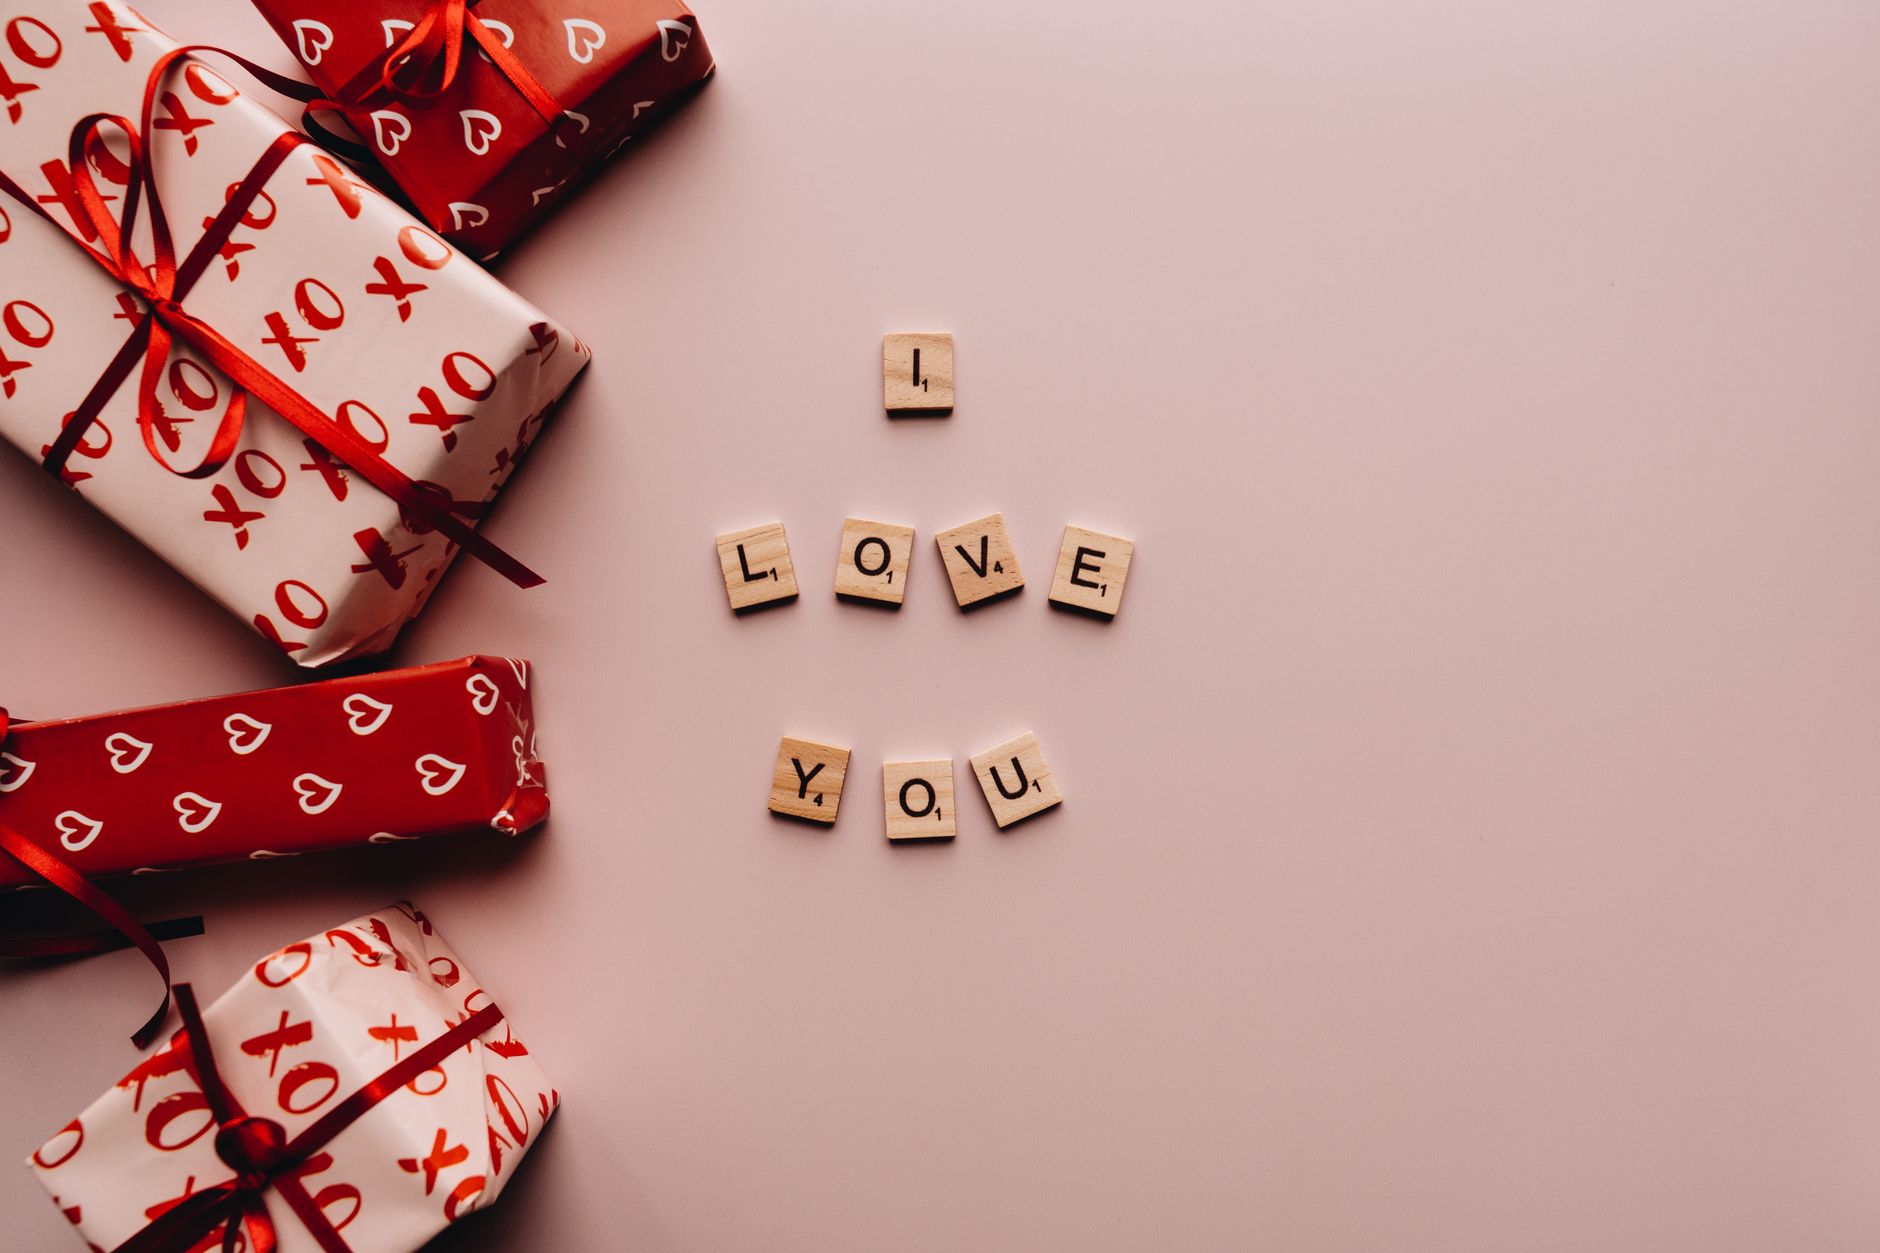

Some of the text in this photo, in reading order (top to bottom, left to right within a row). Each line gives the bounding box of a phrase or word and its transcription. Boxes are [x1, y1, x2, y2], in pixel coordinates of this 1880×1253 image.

[153, 64, 240, 157] XO
[365, 225, 453, 323] XO
[261, 277, 345, 373] XO
[912, 348, 921, 387] I
[408, 351, 497, 453] XO
[204, 449, 286, 551] XO
[240, 1010, 340, 1115] XO
